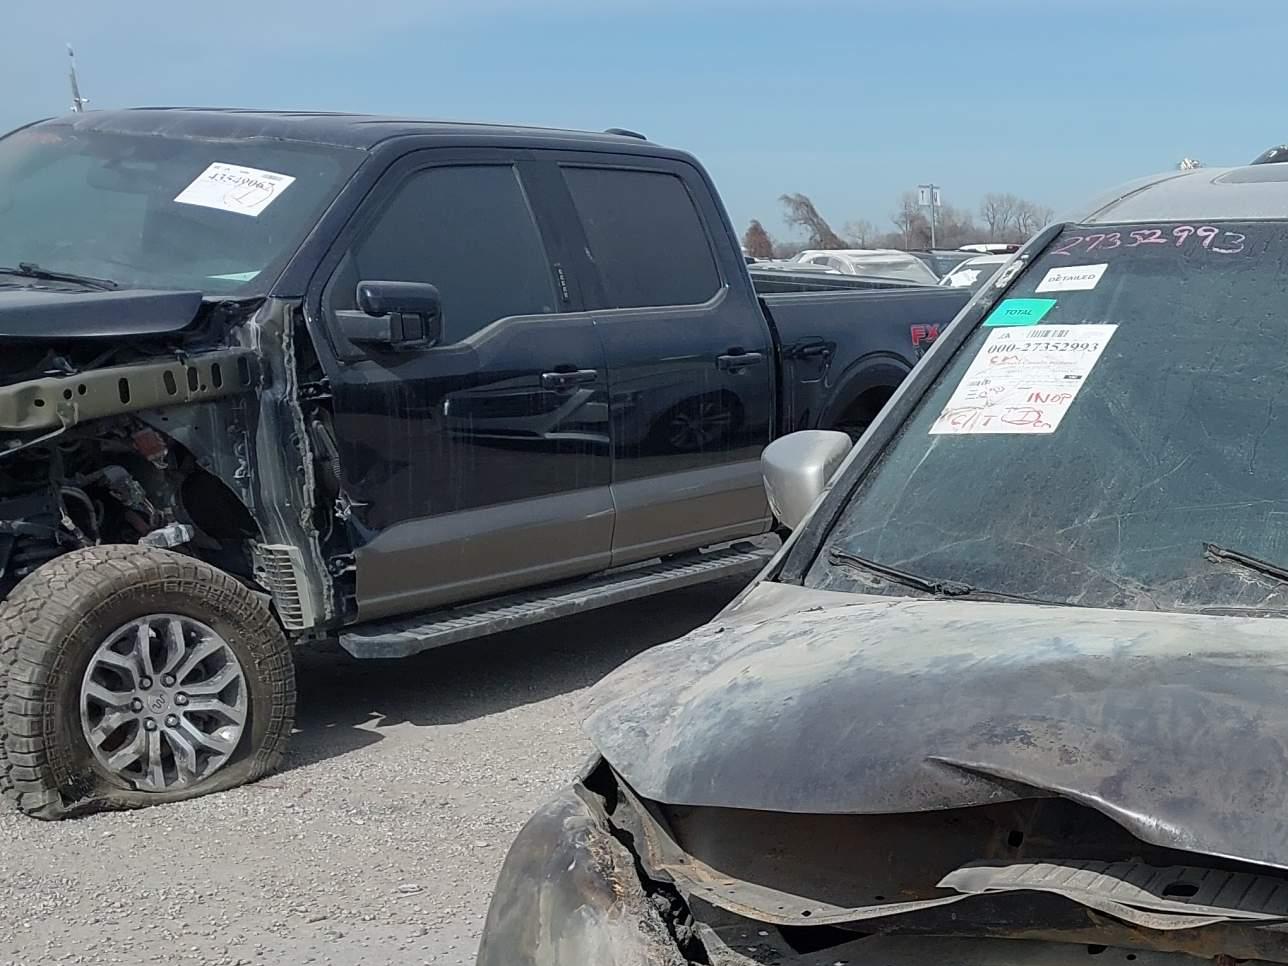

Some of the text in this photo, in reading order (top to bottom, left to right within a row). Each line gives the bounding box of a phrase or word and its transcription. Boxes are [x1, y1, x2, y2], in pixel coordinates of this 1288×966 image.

[1048, 273, 1097, 283] DETAILED
[1004, 308, 1033, 317] TOTAL
[987, 342, 1100, 354] 000-27352993
